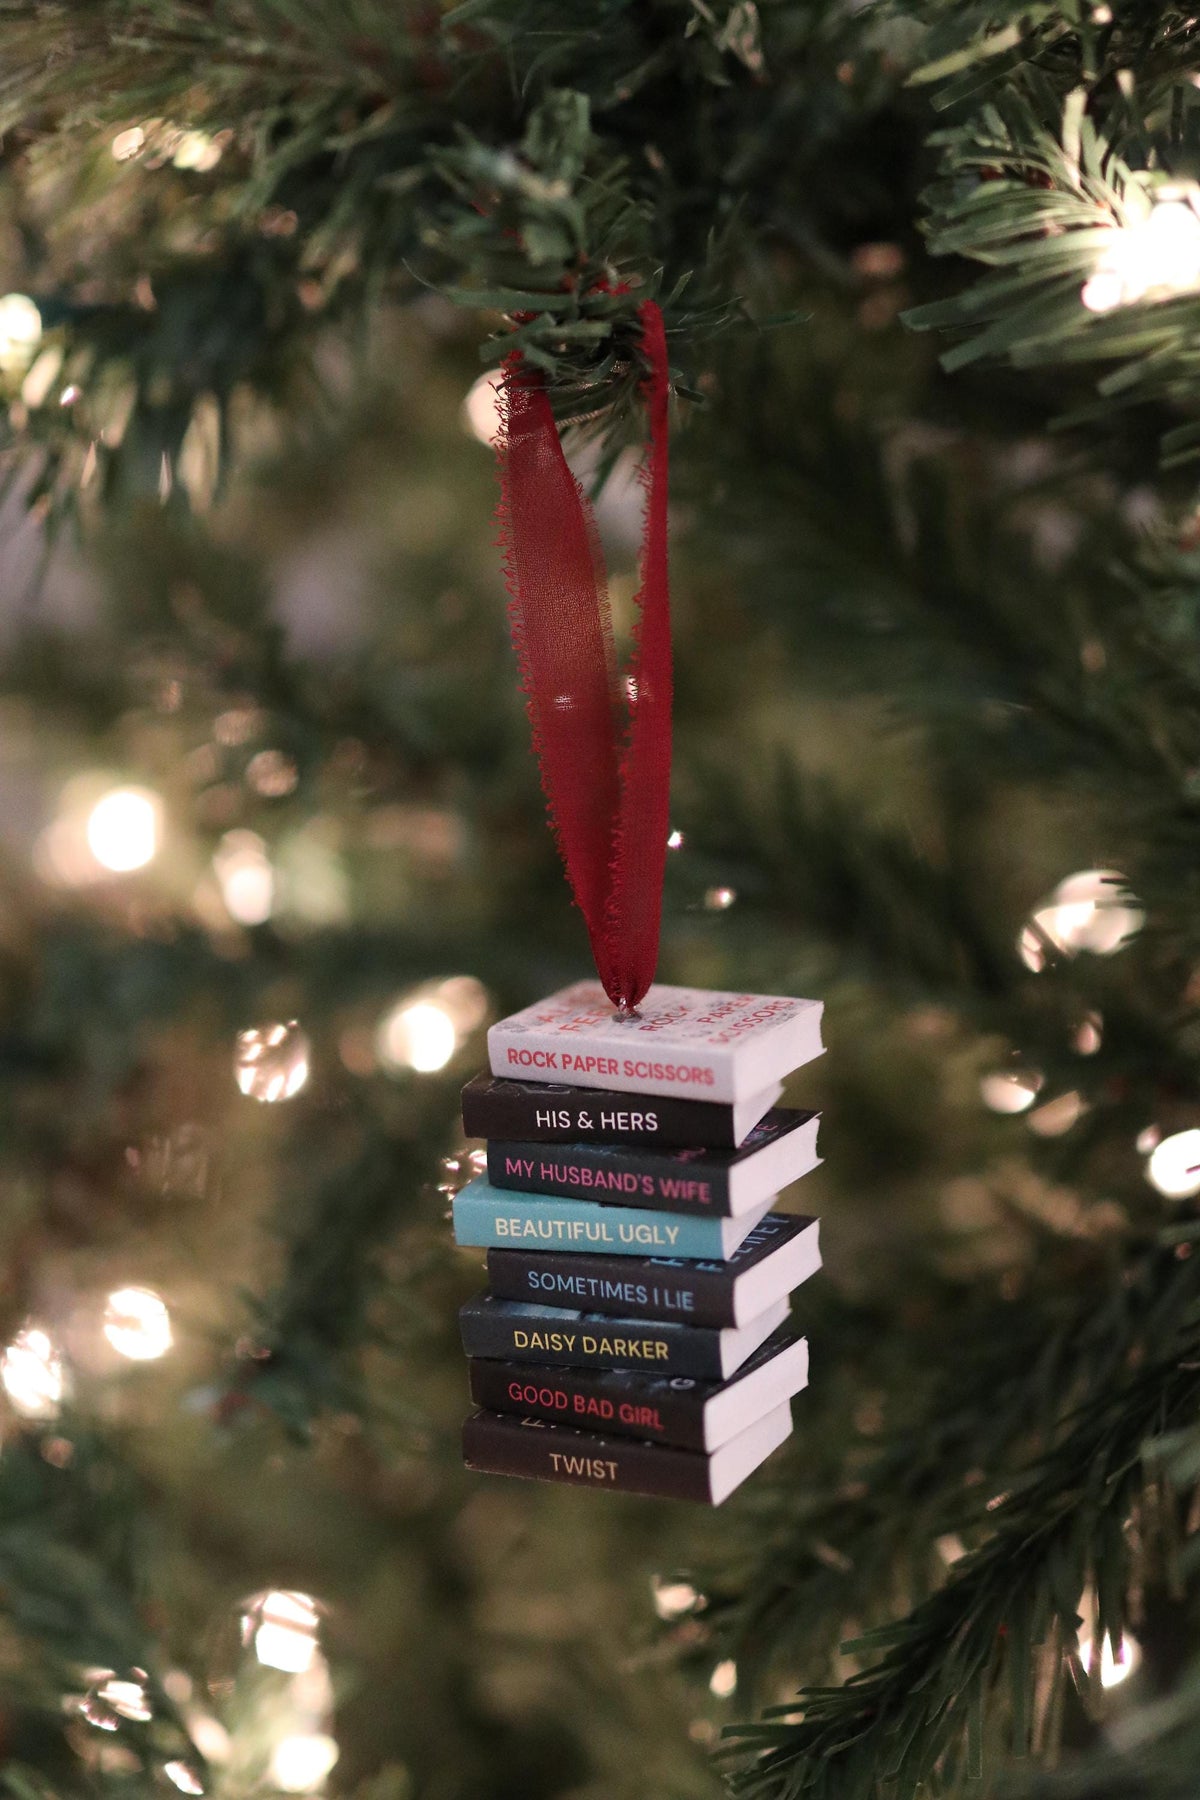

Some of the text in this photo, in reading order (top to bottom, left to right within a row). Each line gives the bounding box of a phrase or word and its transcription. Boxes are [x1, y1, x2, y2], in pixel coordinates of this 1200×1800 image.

[638, 1005, 693, 1032] ROCK
[507, 1047, 715, 1086] ROCK PAPER SCISSORS
[535, 1110, 658, 1131] HIS & HERS
[505, 1157, 711, 1204] MY HUSBAND'S WIFE
[495, 1217, 680, 1245] BEAUTIFUL UGLY
[528, 1270, 695, 1312] SOMETIMES I LIE
[513, 1330, 669, 1360] DAISY DARKER
[508, 1382, 665, 1431] GOOD BAD GIRL
[549, 1452, 619, 1481] TWIST
